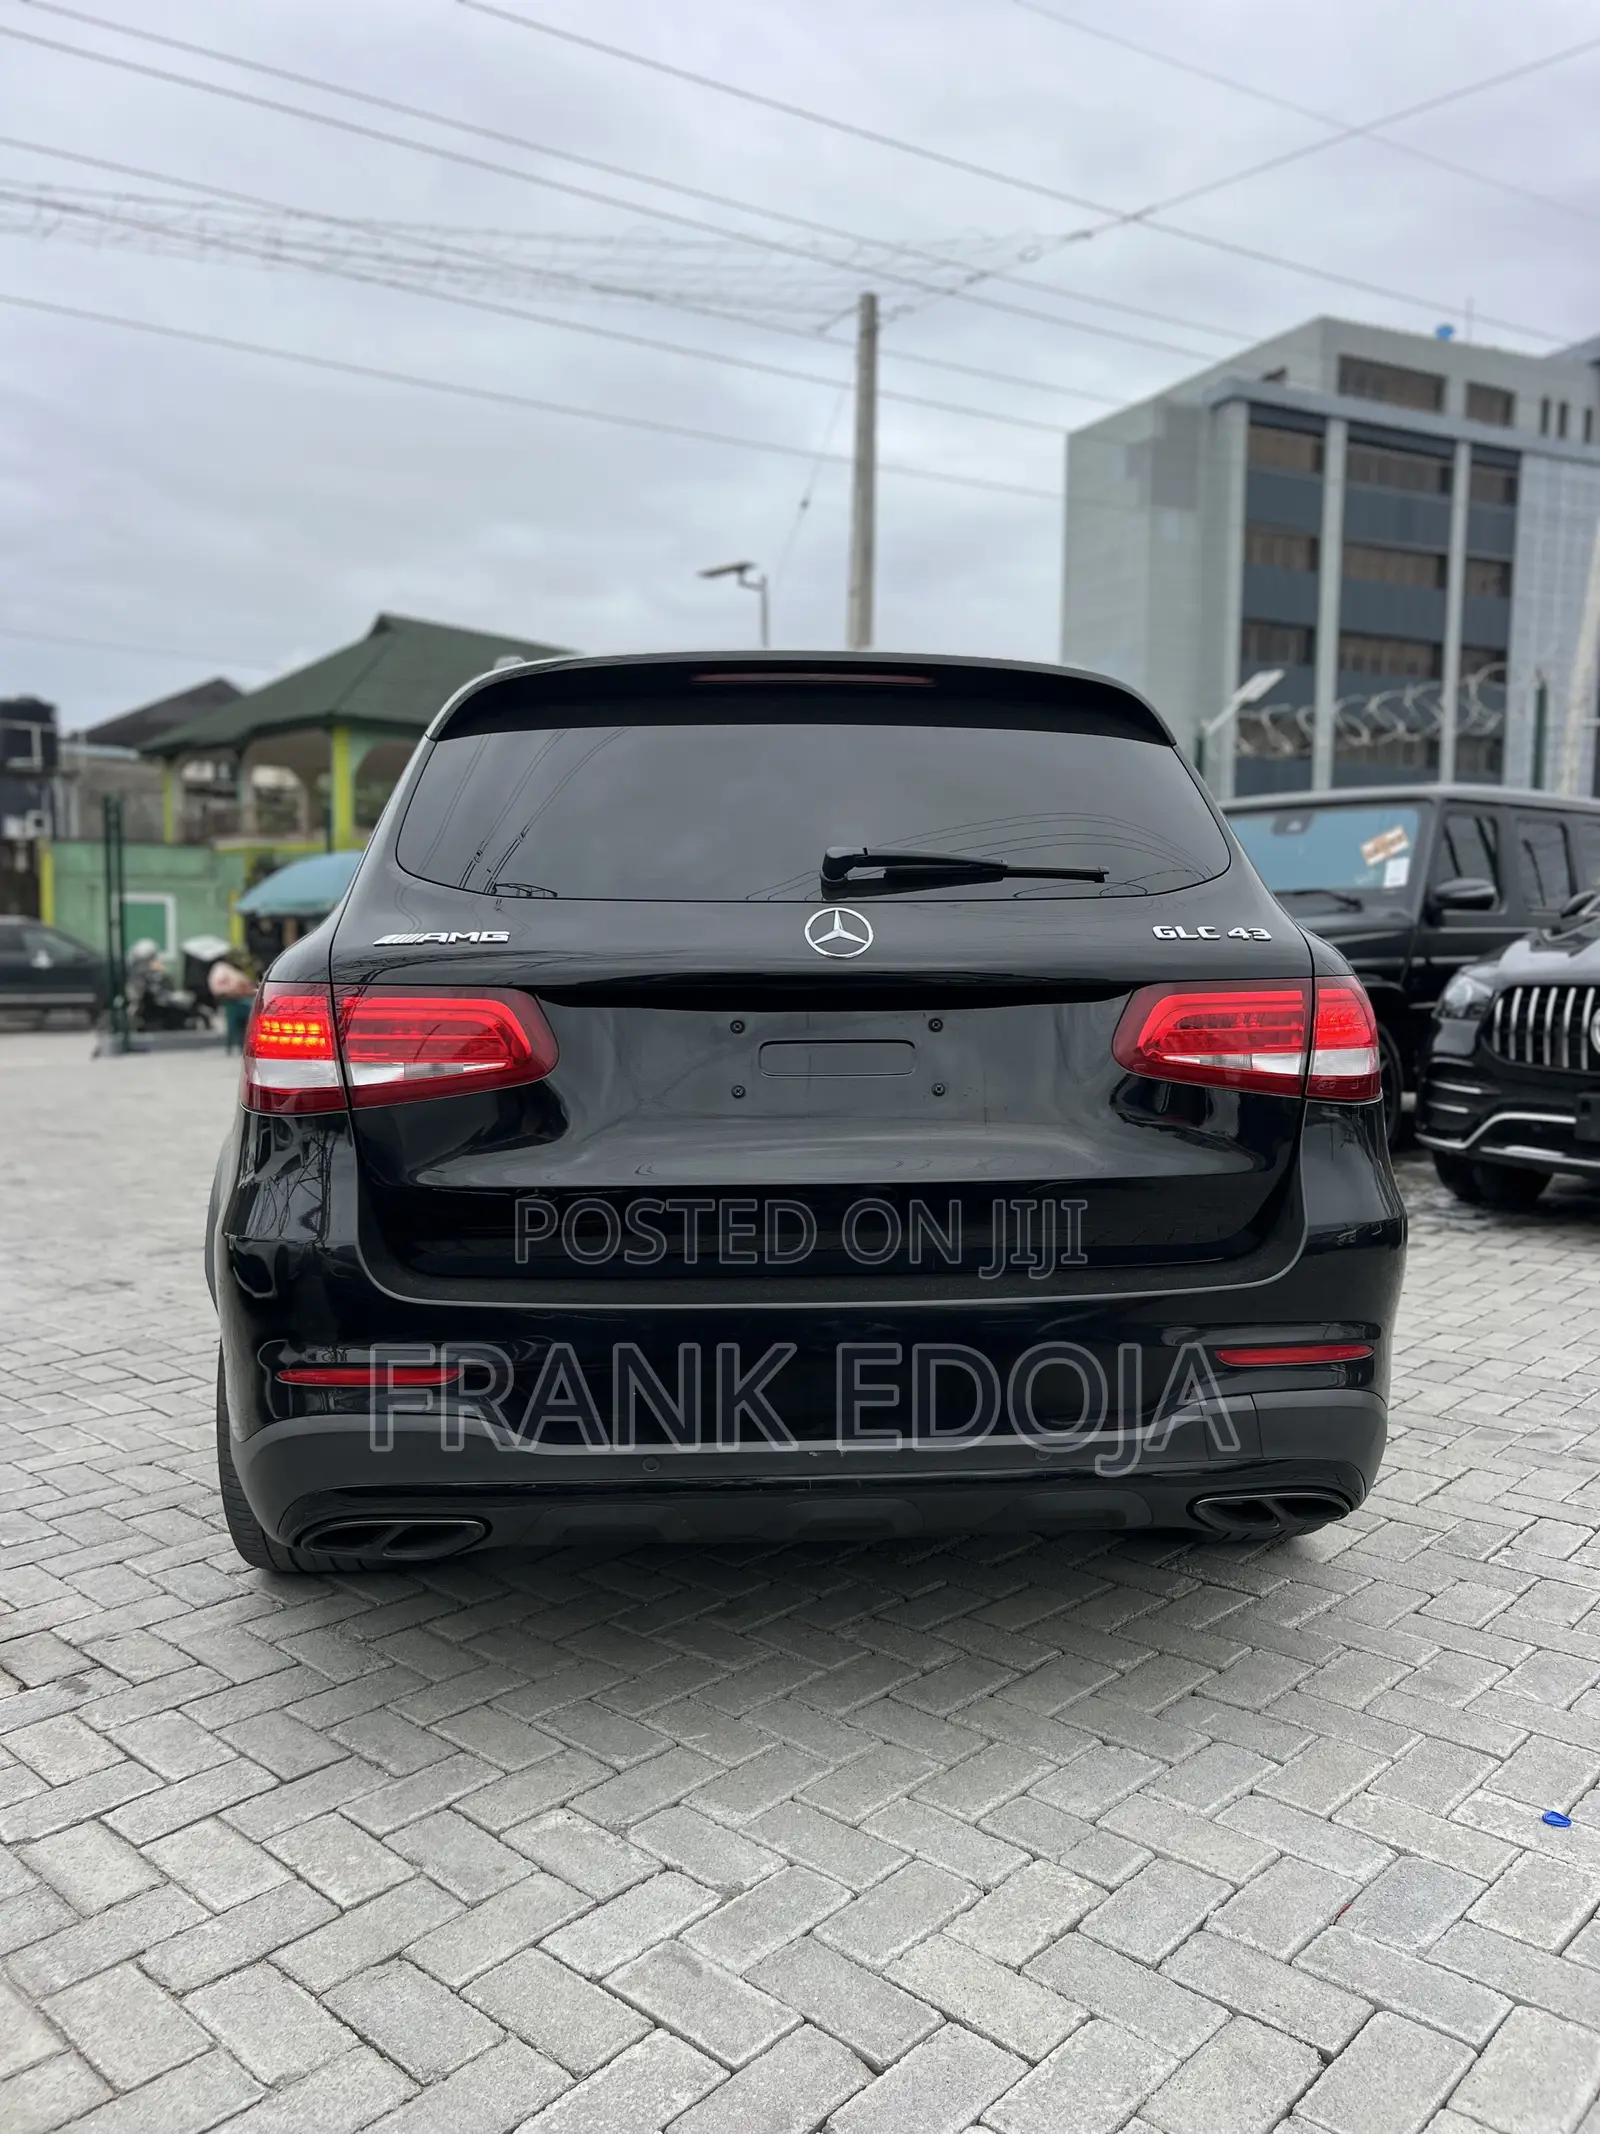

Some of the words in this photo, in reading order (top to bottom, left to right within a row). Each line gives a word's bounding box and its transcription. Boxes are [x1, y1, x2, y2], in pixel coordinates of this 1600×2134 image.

[418, 930, 511, 945] AMG
[1152, 925, 1221, 940] GLC
[1227, 926, 1272, 941] 43
